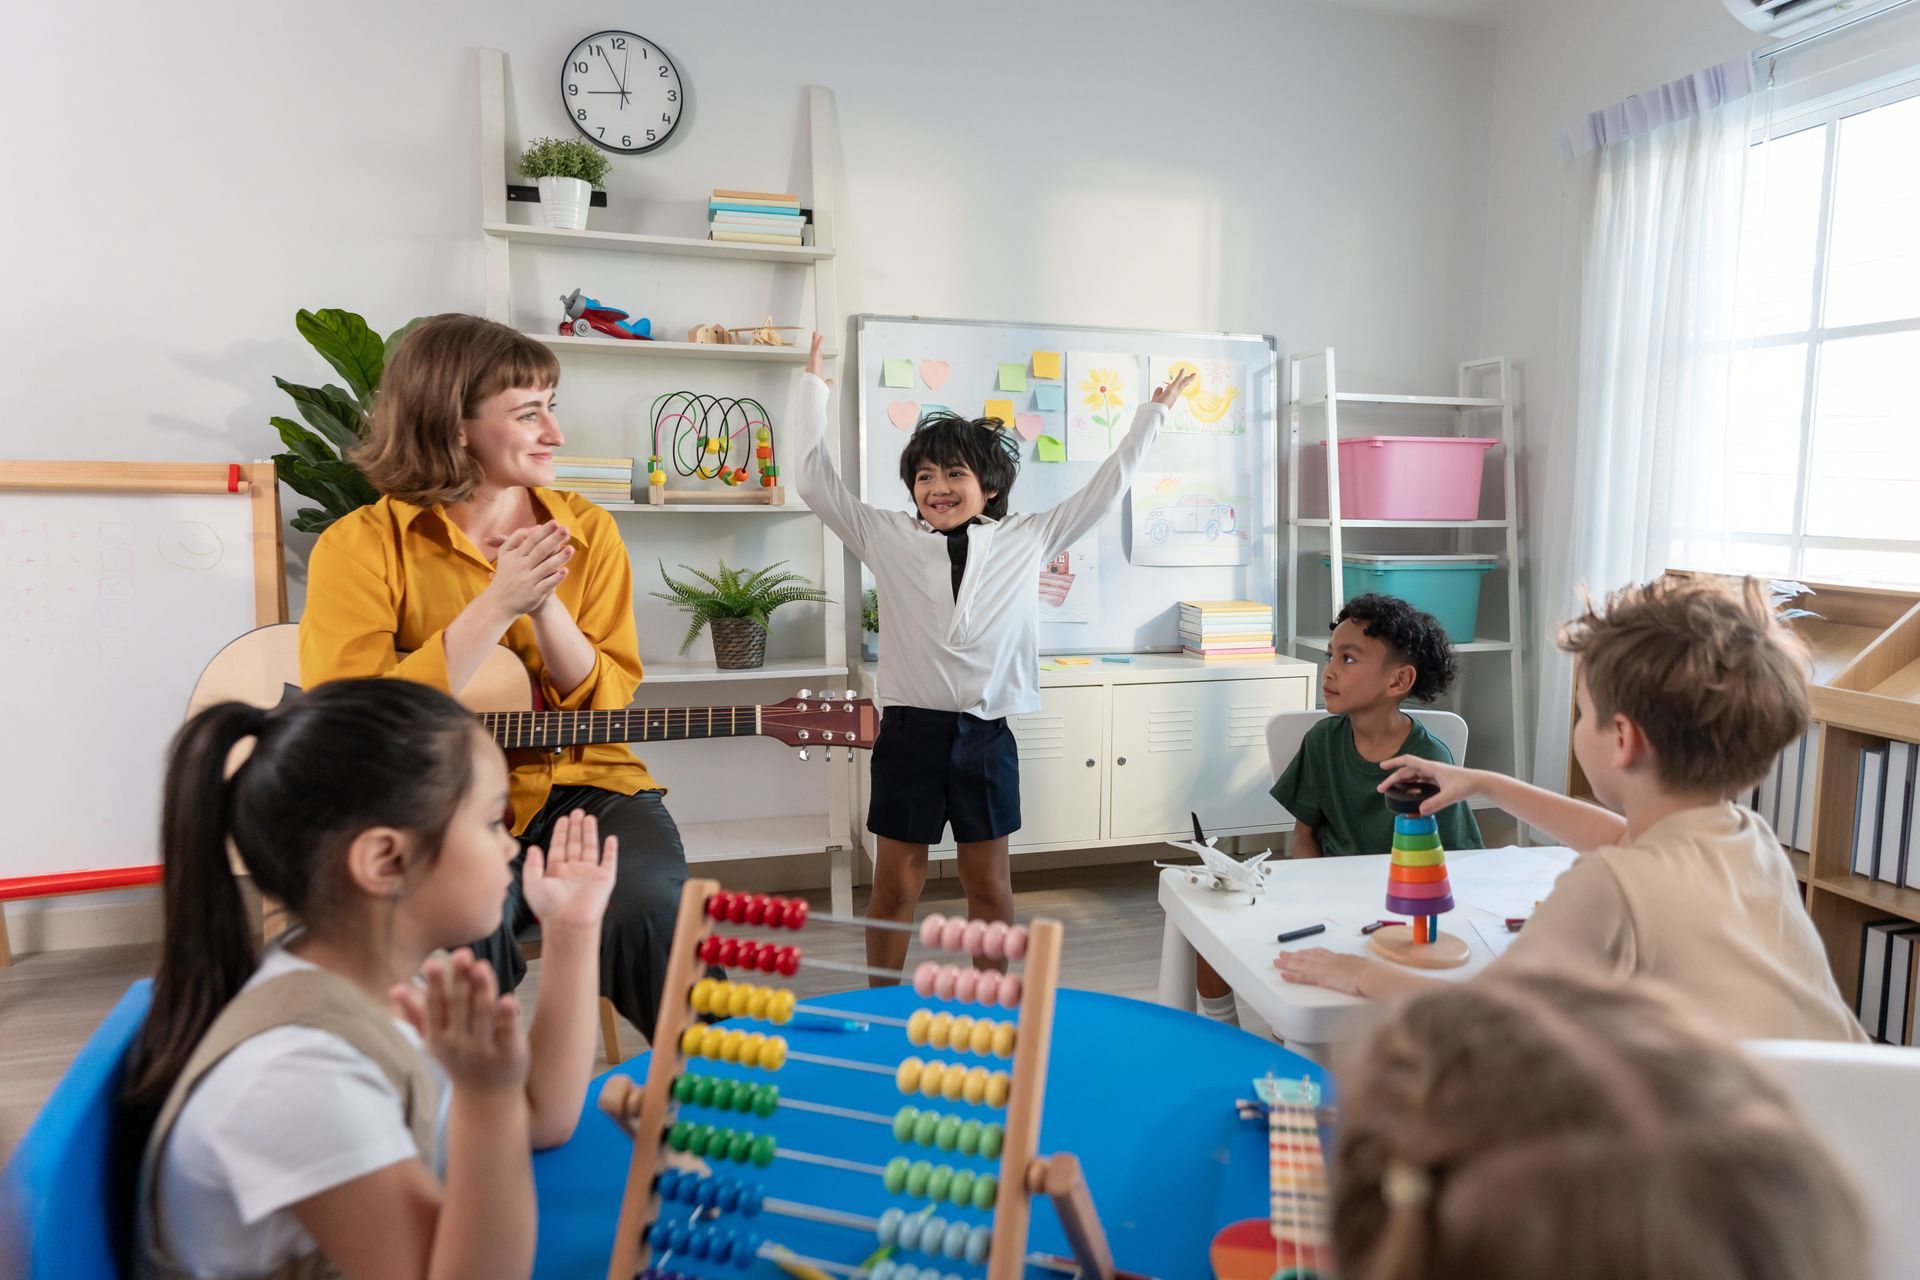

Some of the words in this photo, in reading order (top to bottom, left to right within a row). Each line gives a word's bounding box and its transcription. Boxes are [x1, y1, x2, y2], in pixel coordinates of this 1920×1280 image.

[611, 37, 626, 50] 12
[588, 44, 600, 56] 11
[642, 47, 647, 60] 1
[573, 61, 588, 73] 10
[659, 65, 669, 78] 2
[568, 84, 578, 96] 9
[667, 90, 677, 102] 3
[577, 109, 587, 121] 8
[662, 112, 671, 124] 4
[597, 126, 606, 139] 7
[646, 129, 656, 141] 5
[622, 135, 632, 147] 6
